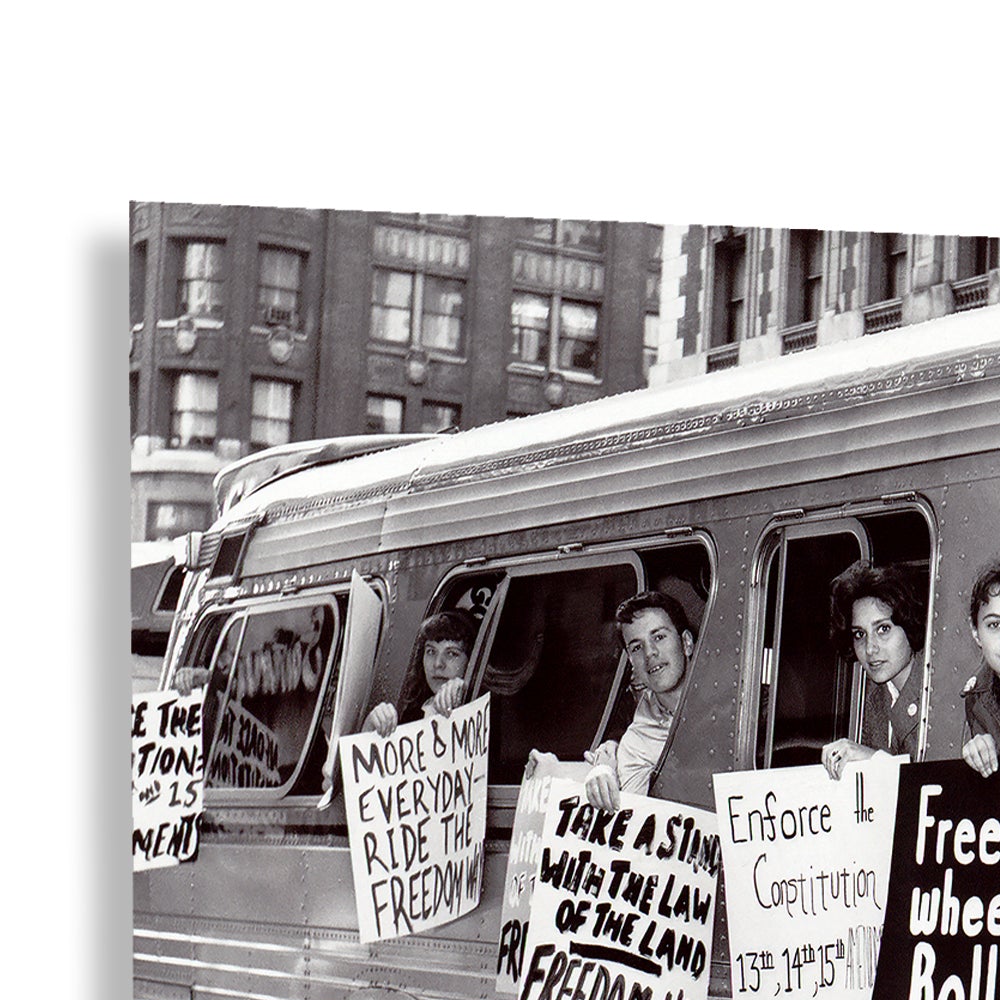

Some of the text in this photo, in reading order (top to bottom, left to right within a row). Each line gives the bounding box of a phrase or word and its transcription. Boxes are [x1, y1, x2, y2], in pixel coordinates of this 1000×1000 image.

[158, 699, 201, 738] THE
[352, 702, 490, 783] MORE & MORE
[363, 816, 431, 876] RIDE
[440, 803, 474, 855] THE
[555, 796, 633, 851] TAKE
[633, 813, 656, 856] A
[728, 772, 874, 844] Enforce the
[371, 860, 464, 938] FREEDOM
[540, 848, 712, 925] WITH THE LAW
[753, 853, 882, 919] Constitution
[555, 899, 706, 980] OF THE LAND
